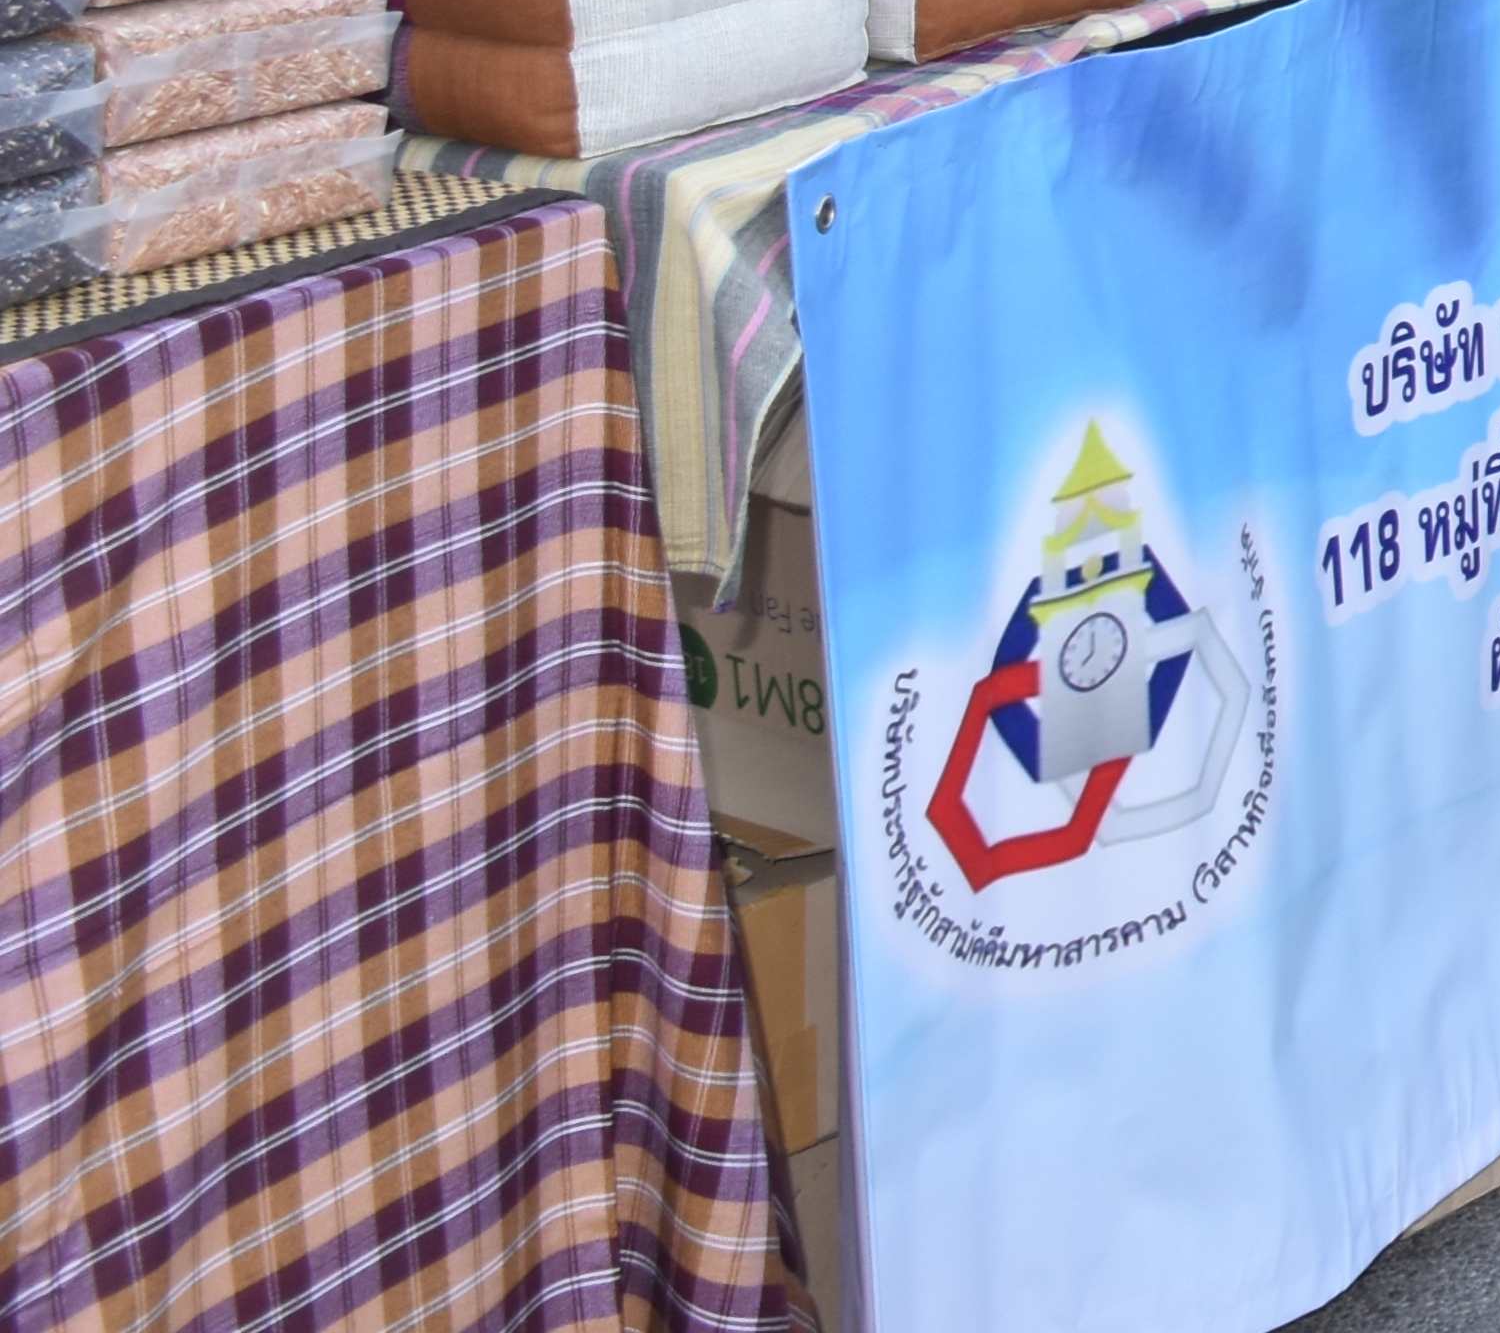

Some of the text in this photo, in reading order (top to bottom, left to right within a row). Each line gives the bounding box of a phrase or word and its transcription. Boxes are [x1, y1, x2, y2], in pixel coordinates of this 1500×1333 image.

[1361, 299, 1485, 419] บริษัท
[1320, 519, 1401, 606] 118
